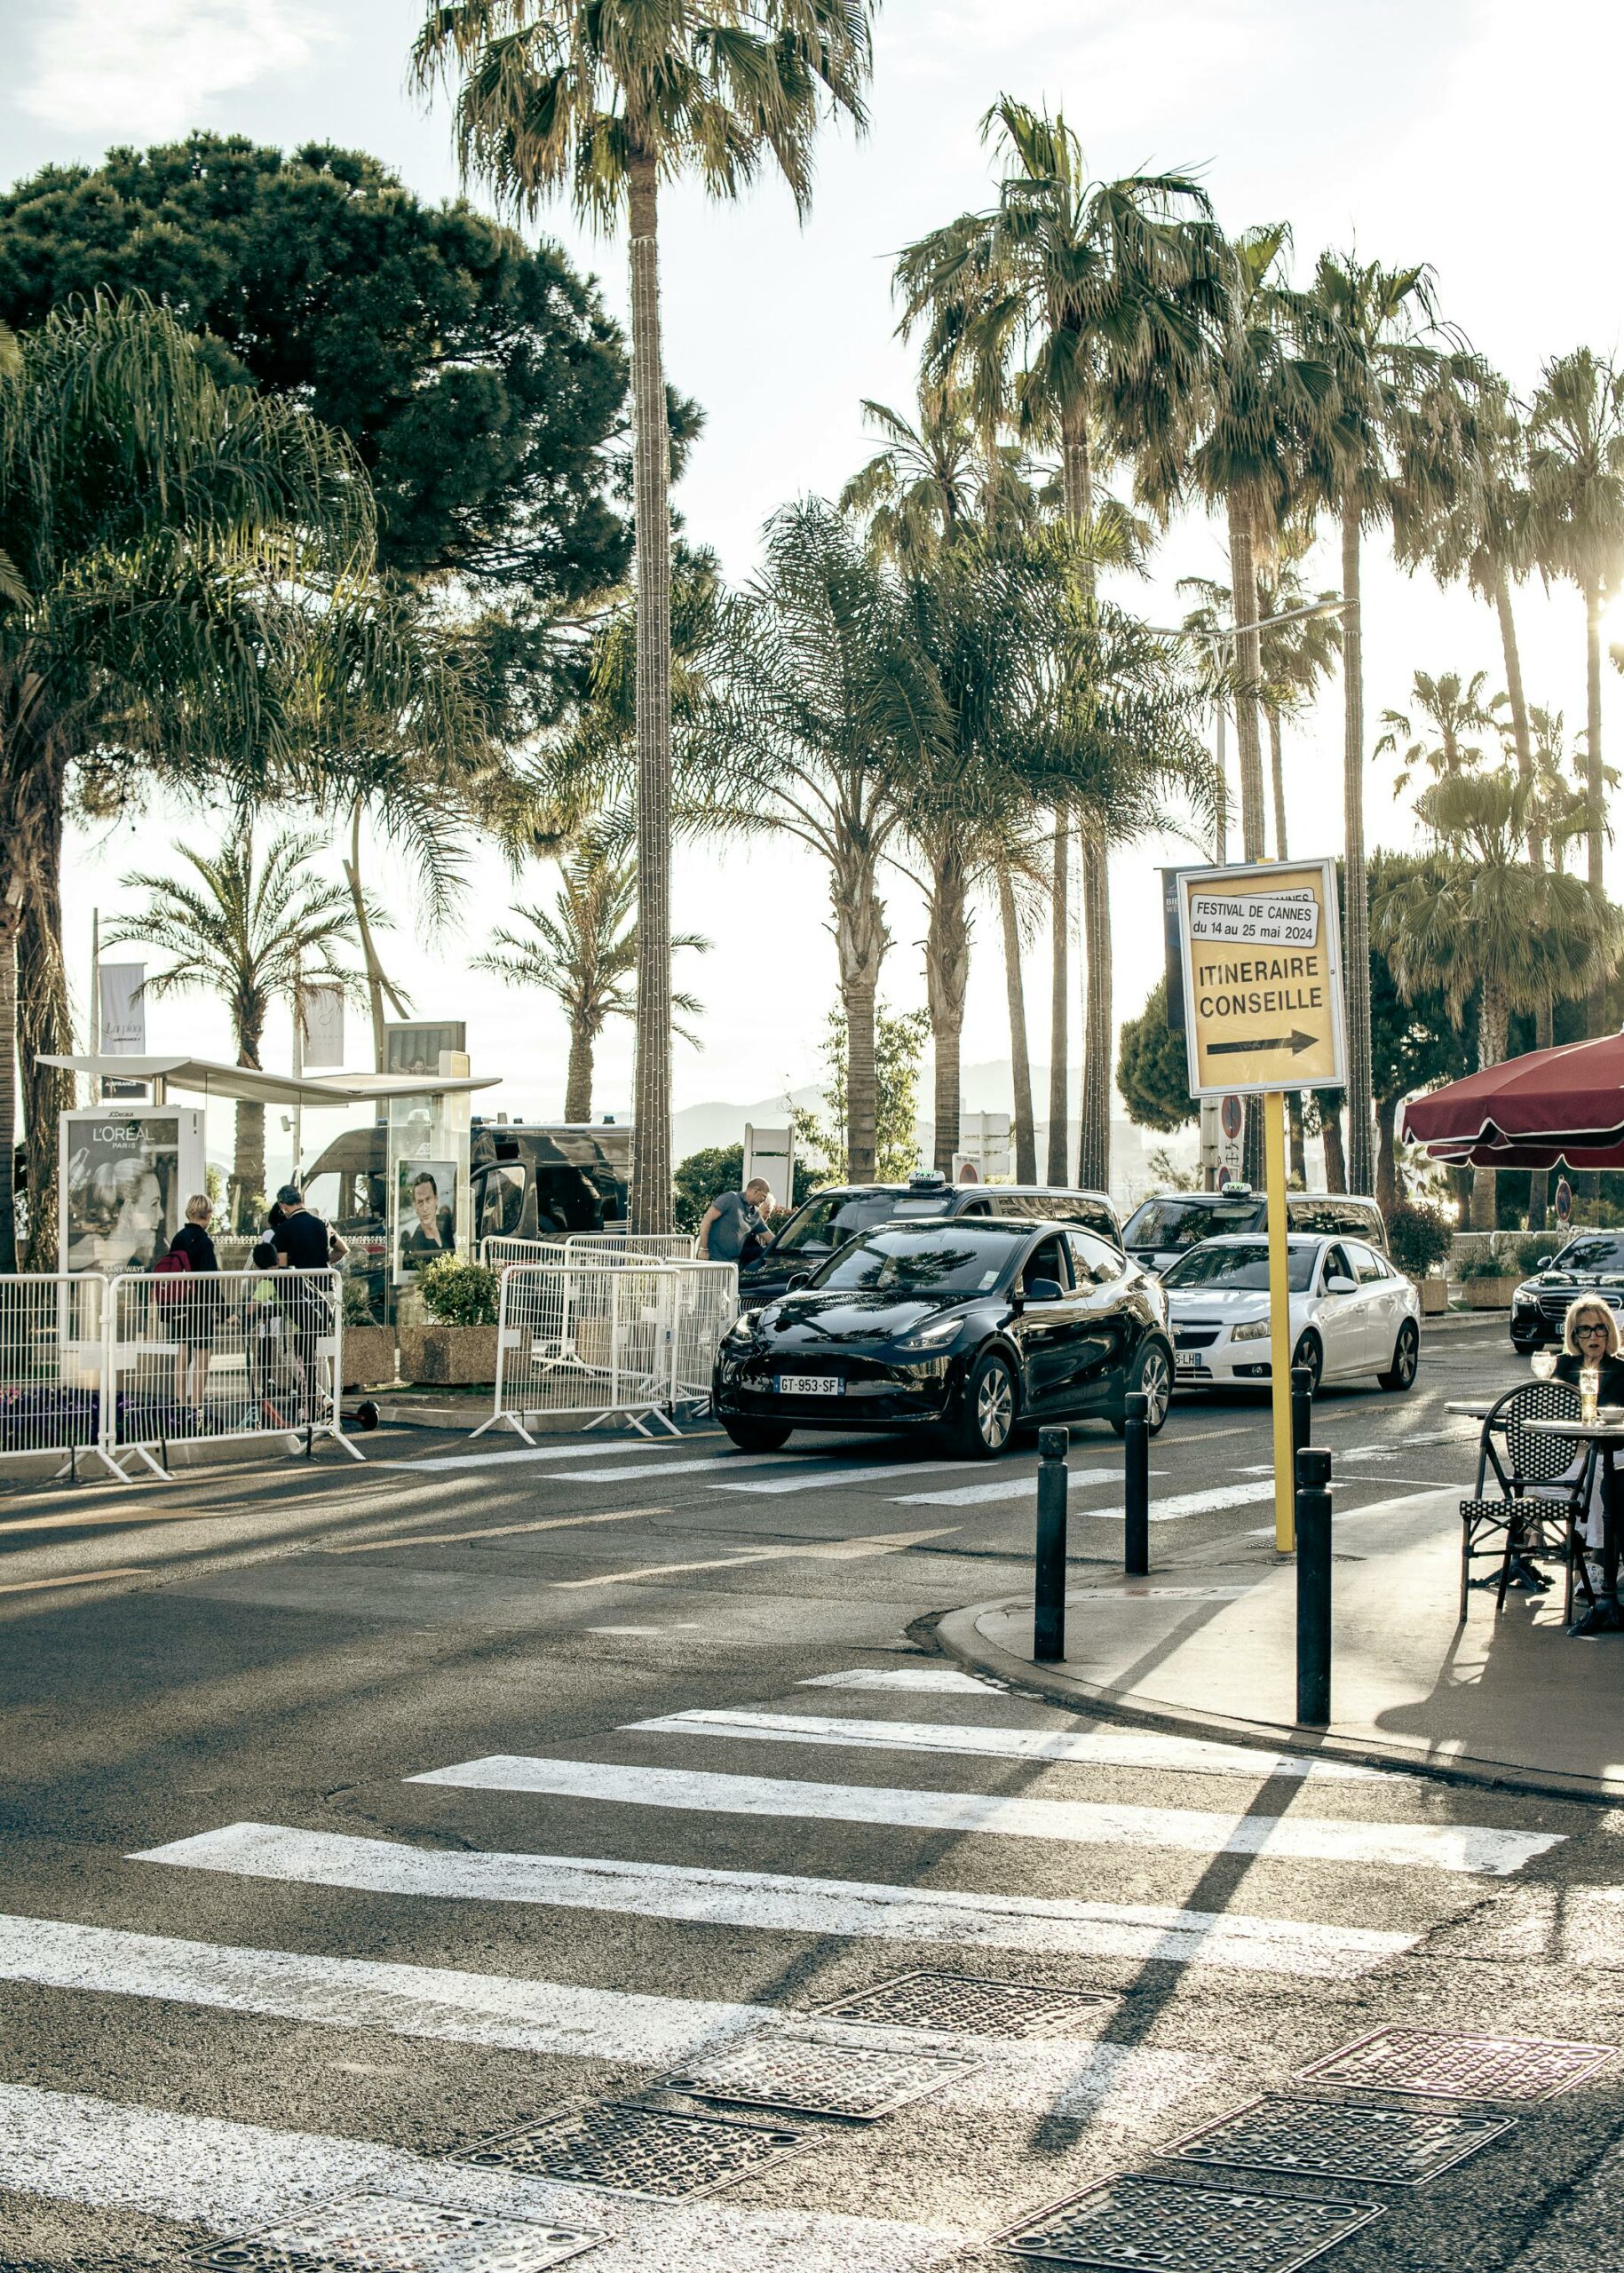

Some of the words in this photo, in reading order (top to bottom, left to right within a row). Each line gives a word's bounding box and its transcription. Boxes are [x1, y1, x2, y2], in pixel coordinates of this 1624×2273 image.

[1197, 902, 1245, 917] FESTIVAL
[1248, 905, 1264, 918] DE
[1268, 907, 1311, 921] CANNES
[1193, 921, 1208, 933] du
[1211, 923, 1223, 934] 14
[1224, 925, 1238, 935] au
[1242, 924, 1256, 936] 25
[1260, 926, 1280, 938] mai
[1285, 927, 1312, 939] 2024
[1200, 956, 1319, 986] ITINERAIRE
[1200, 987, 1322, 1018] CONSEILLE
[92, 1126, 155, 1142] L'ORÉAL
[1176, 1354, 1194, 1365] 5-LH
[781, 1378, 836, 1392] GT-953-SF
